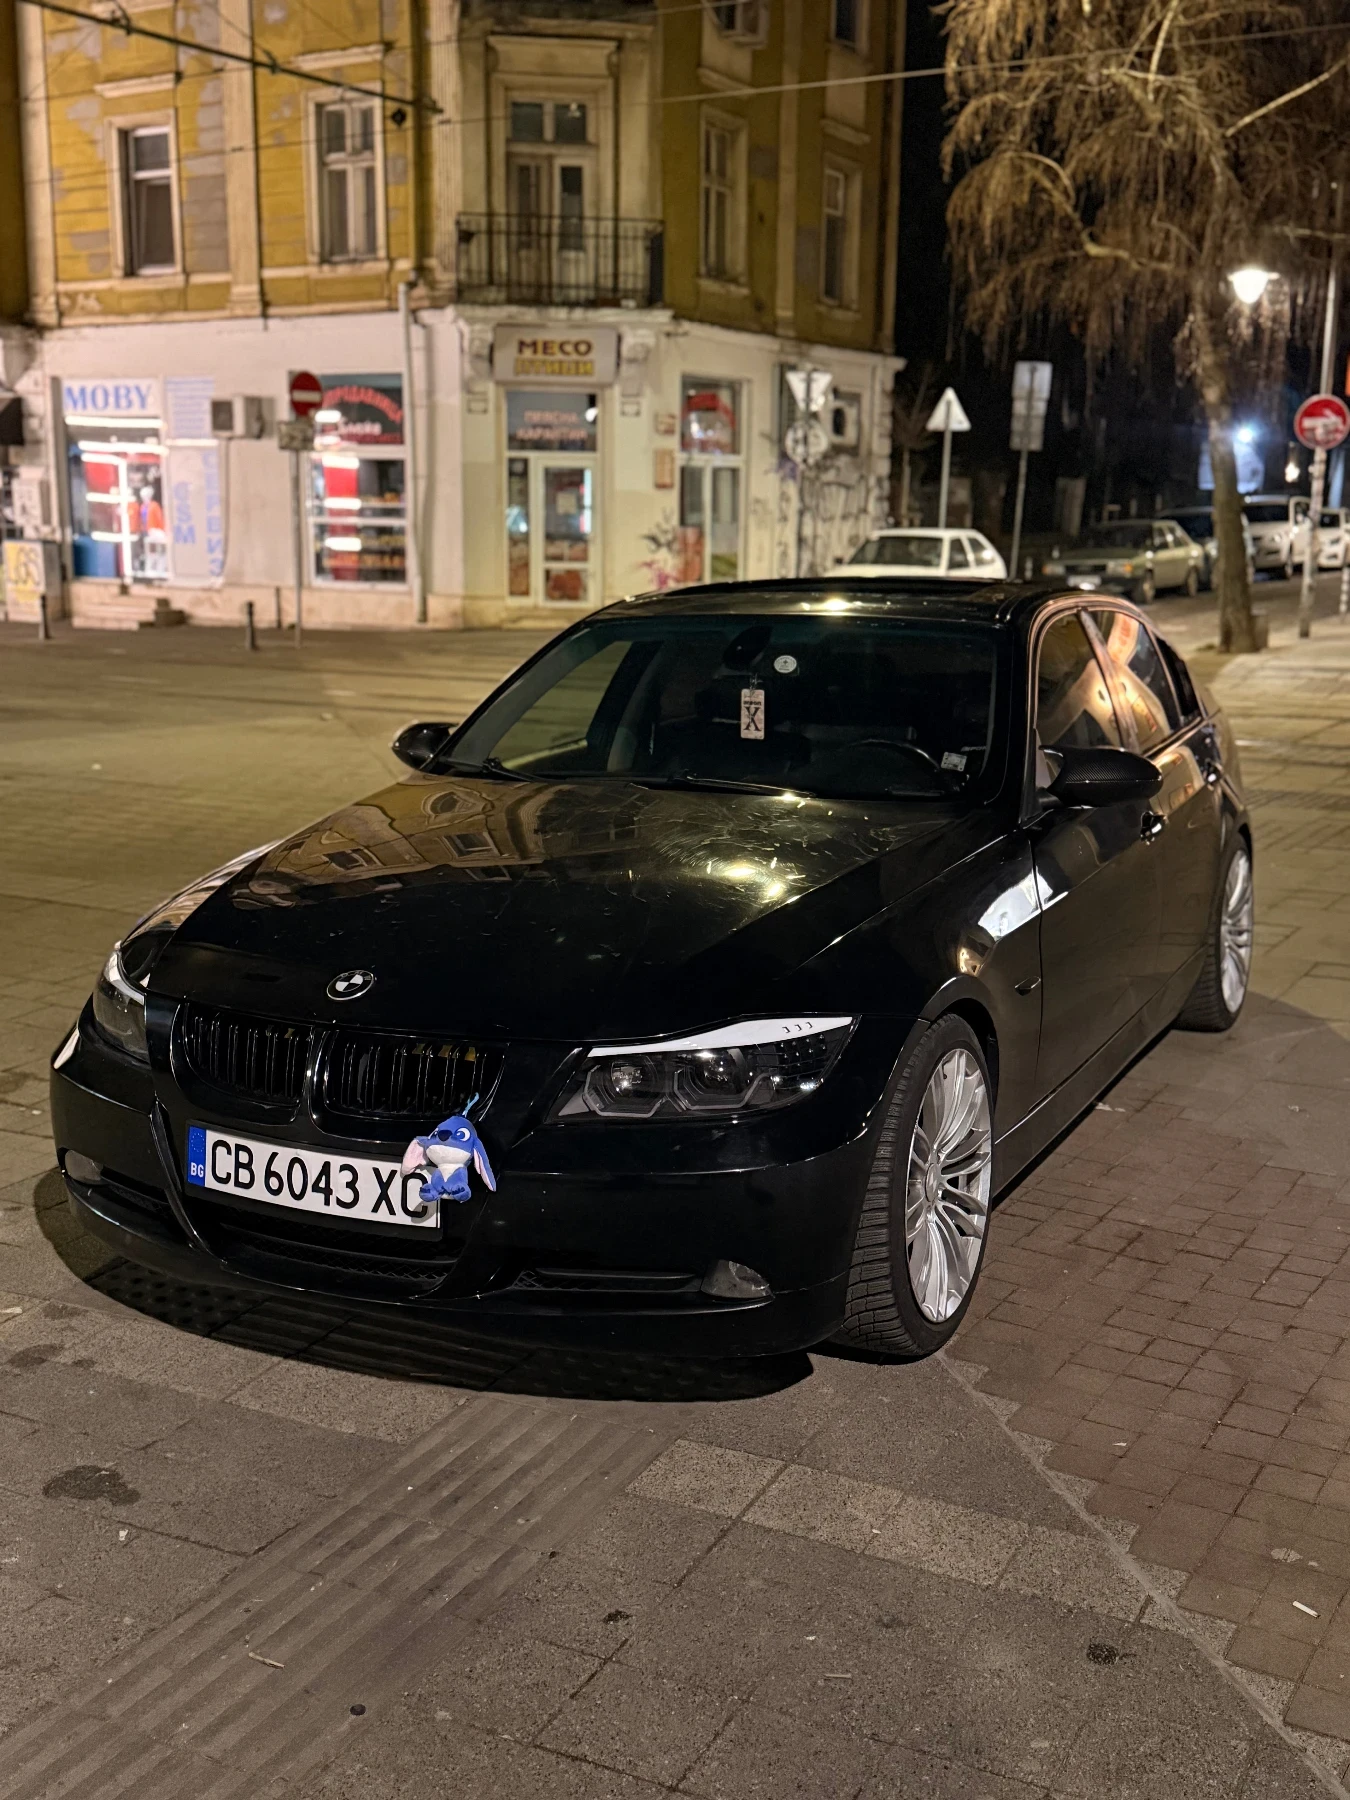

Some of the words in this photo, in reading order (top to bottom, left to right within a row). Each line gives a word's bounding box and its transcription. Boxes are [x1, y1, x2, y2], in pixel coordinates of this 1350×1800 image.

[517, 339, 593, 356] МЕСО
[64, 384, 152, 412] MOBY
[743, 706, 762, 732] X
[190, 1162, 204, 1178] BG
[211, 1139, 256, 1190] CB
[264, 1151, 360, 1209] 6043
